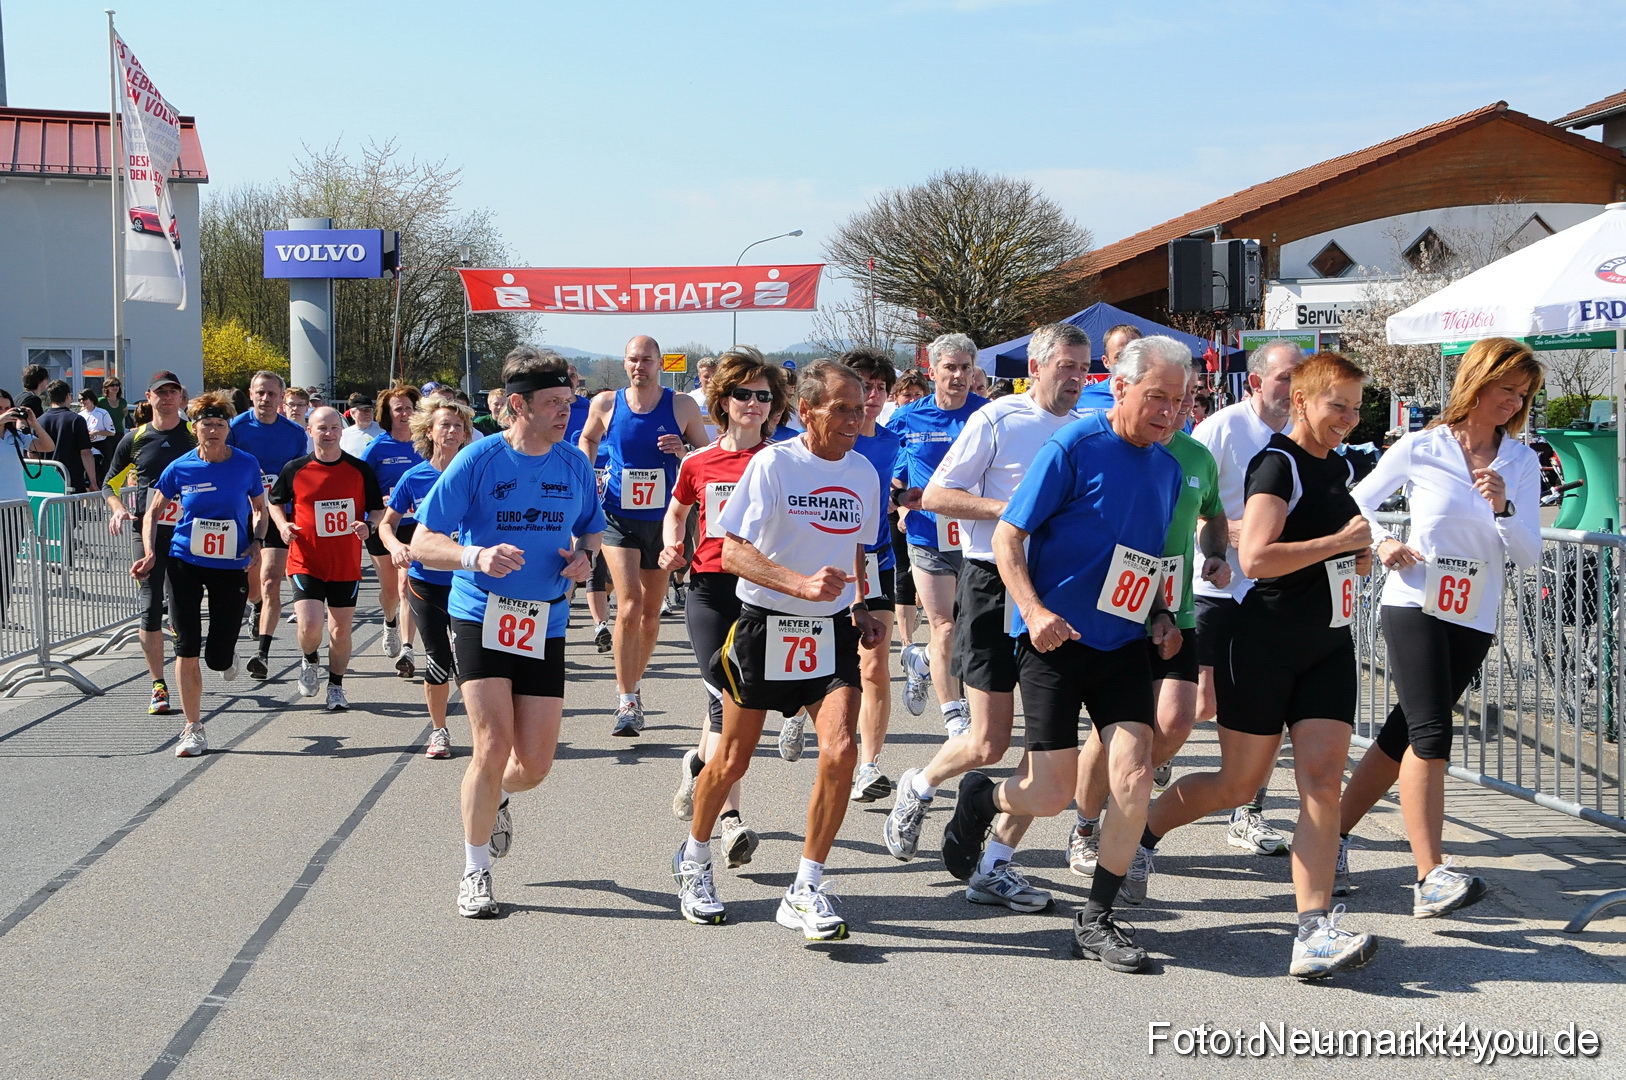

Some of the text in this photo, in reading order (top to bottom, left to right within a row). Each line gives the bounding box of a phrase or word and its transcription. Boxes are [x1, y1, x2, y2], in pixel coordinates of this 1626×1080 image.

[130, 169, 147, 181] DEN
[274, 244, 366, 262] VOLVO
[1441, 310, 1495, 334] Weißbier
[632, 482, 656, 506] 57
[788, 495, 854, 510] GERHART
[496, 511, 564, 523] EURO PLUS
[788, 508, 821, 516] Autohaus
[325, 511, 348, 534] 68
[496, 523, 562, 532] Aichner-Filter-Werk
[947, 521, 960, 546] 6
[203, 532, 225, 555] 61
[1124, 551, 1151, 567] MEYER
[1437, 557, 1468, 568] MEYER
[1111, 569, 1150, 613] 80
[1342, 578, 1352, 618] 6
[1438, 575, 1471, 614] 63
[499, 597, 528, 609] MEYER
[497, 613, 536, 652] 82
[778, 619, 810, 628] MEYER
[778, 626, 810, 634] WERBUNG
[783, 636, 817, 673] 73
